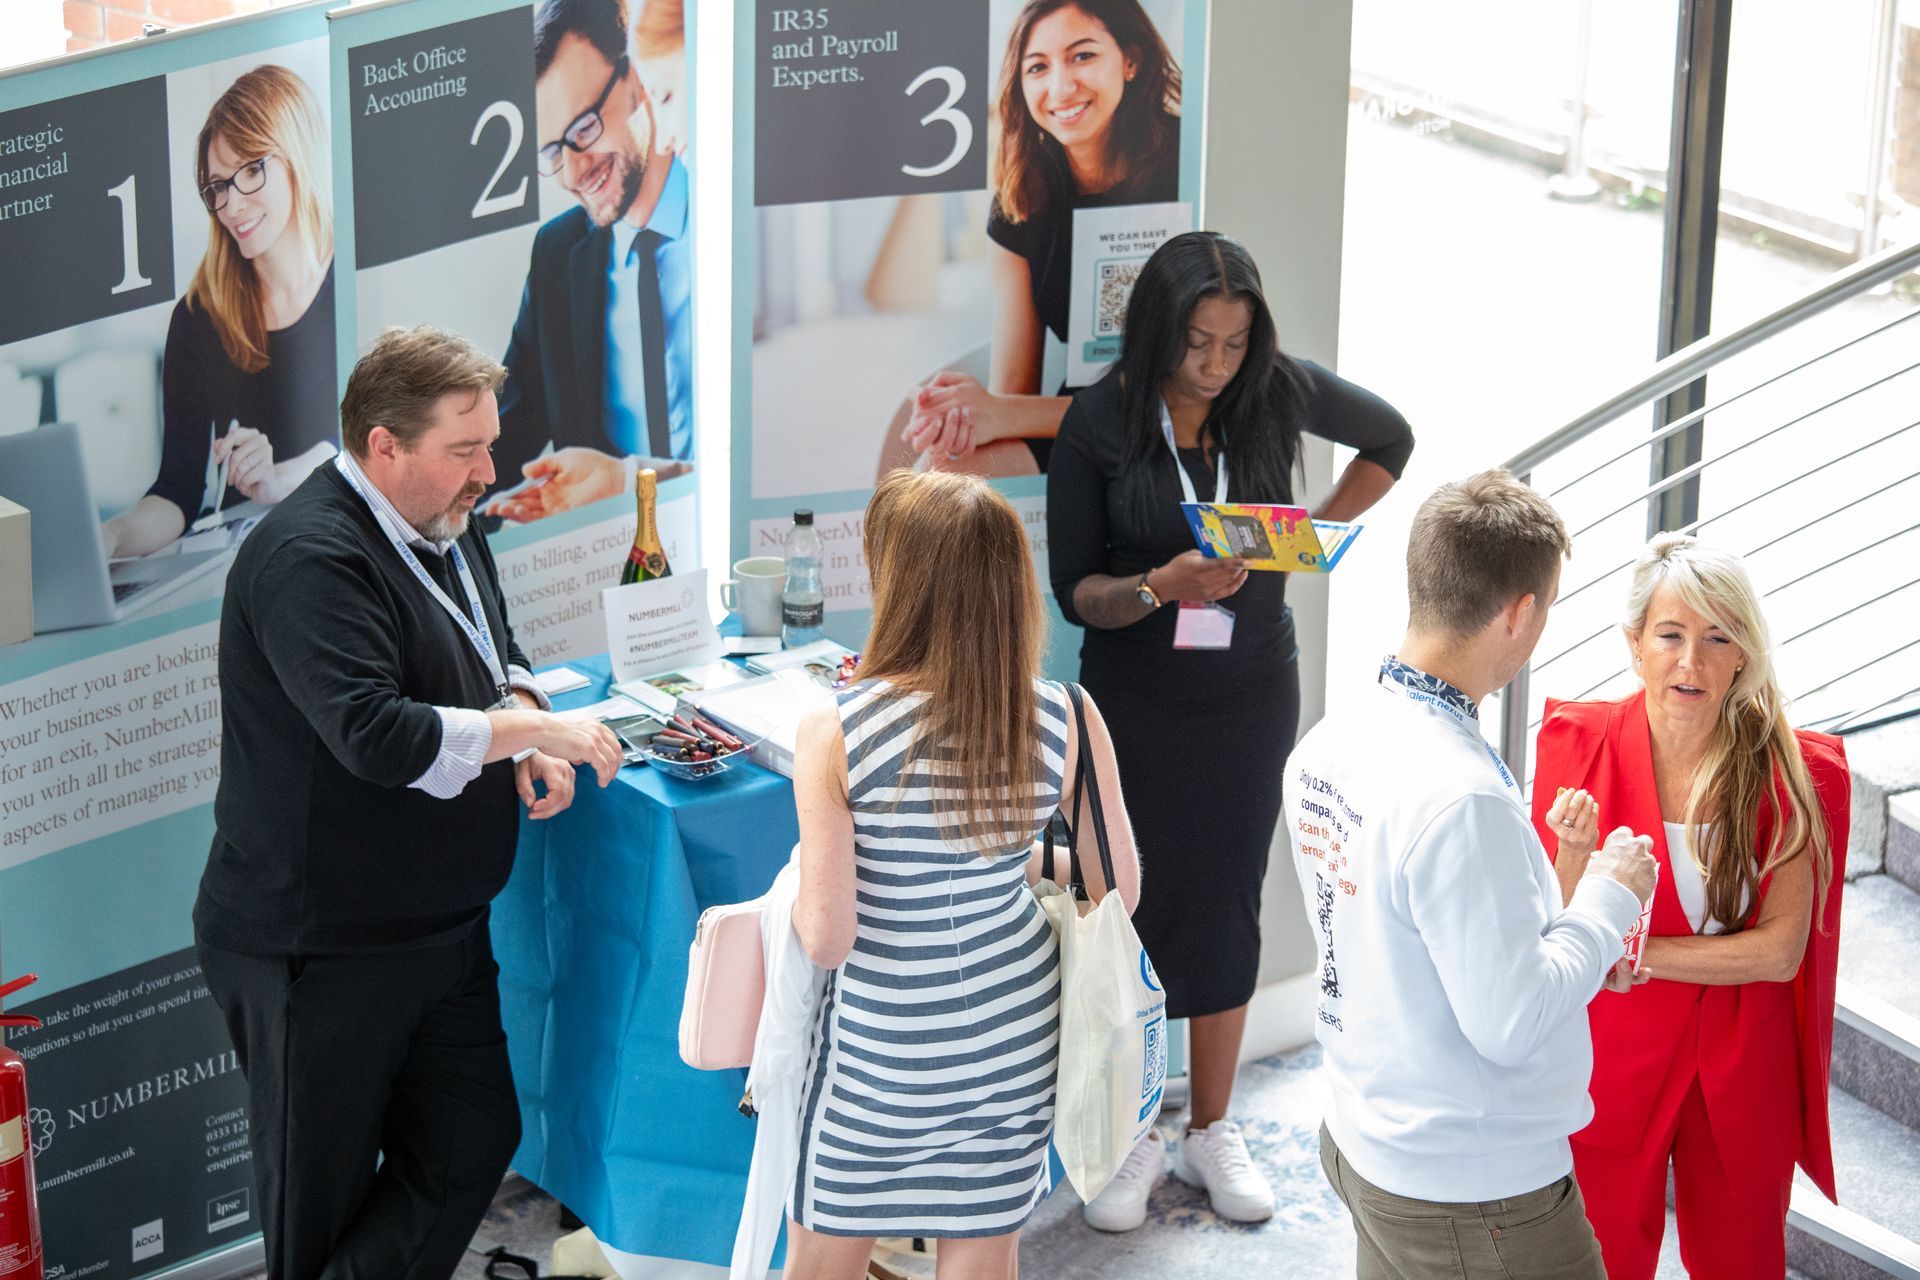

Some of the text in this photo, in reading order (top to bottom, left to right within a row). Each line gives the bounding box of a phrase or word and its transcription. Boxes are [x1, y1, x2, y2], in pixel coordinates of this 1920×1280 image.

[772, 8, 829, 32] IR35
[772, 31, 899, 60] and Payroll
[363, 46, 467, 87] Back Office
[772, 66, 865, 90] Experts.
[364, 75, 467, 116] Accounting
[901, 65, 973, 177] 3
[470, 100, 529, 219] 2
[107, 174, 152, 295] 1
[1100, 229, 1167, 242] WE CAN SAVE
[1109, 244, 1131, 253] YOU
[396, 540, 433, 588] talent nexus
[512, 563, 528, 577] to
[532, 547, 588, 573] billing,
[832, 552, 848, 568] in
[473, 601, 485, 632] talent
[523, 598, 593, 638] specialist
[628, 604, 682, 622] NUMBERMILL
[456, 612, 492, 660] talent nexus
[532, 638, 572, 665] pace.
[0, 684, 78, 721] Whether
[84, 674, 117, 699] you
[124, 664, 151, 684] are
[1406, 689, 1464, 721] talent nexus
[0, 728, 41, 758] your
[47, 703, 122, 738] business
[128, 694, 147, 713] or
[152, 684, 179, 710] get
[185, 677, 197, 695] it
[1, 698, 218, 785] for an exit, NumberMill
[2, 730, 222, 819] you with all the strategic
[1312, 777, 1333, 797] 0.2%
[1499, 765, 1514, 788] nexus
[3, 813, 67, 847] aspects
[73, 798, 93, 821] of
[98, 776, 188, 816] managing
[1298, 818, 1320, 837] Scan
[9, 1025, 28, 1040] Let
[47, 1010, 70, 1026] take
[72, 1003, 91, 1018] the
[93, 989, 129, 1012] weight
[132, 980, 146, 997] of
[146, 975, 170, 993] your
[17, 1036, 70, 1061] bligations
[73, 1029, 86, 1042] so
[88, 1020, 110, 1037] that
[112, 1015, 133, 1032] you
[136, 1006, 155, 1020] can
[158, 993, 191, 1014] spend
[67, 1050, 241, 1129] NUMBERMIL
[206, 1107, 244, 1127] Contact
[206, 1127, 230, 1143] 0333
[206, 1136, 248, 1158] Or email
[36, 1146, 136, 1192] .numbermill.co.uk
[206, 1149, 253, 1174] enquirie
[217, 1198, 241, 1217] ipse
[135, 1233, 162, 1250] ACCA
[79, 1259, 110, 1277] Member
